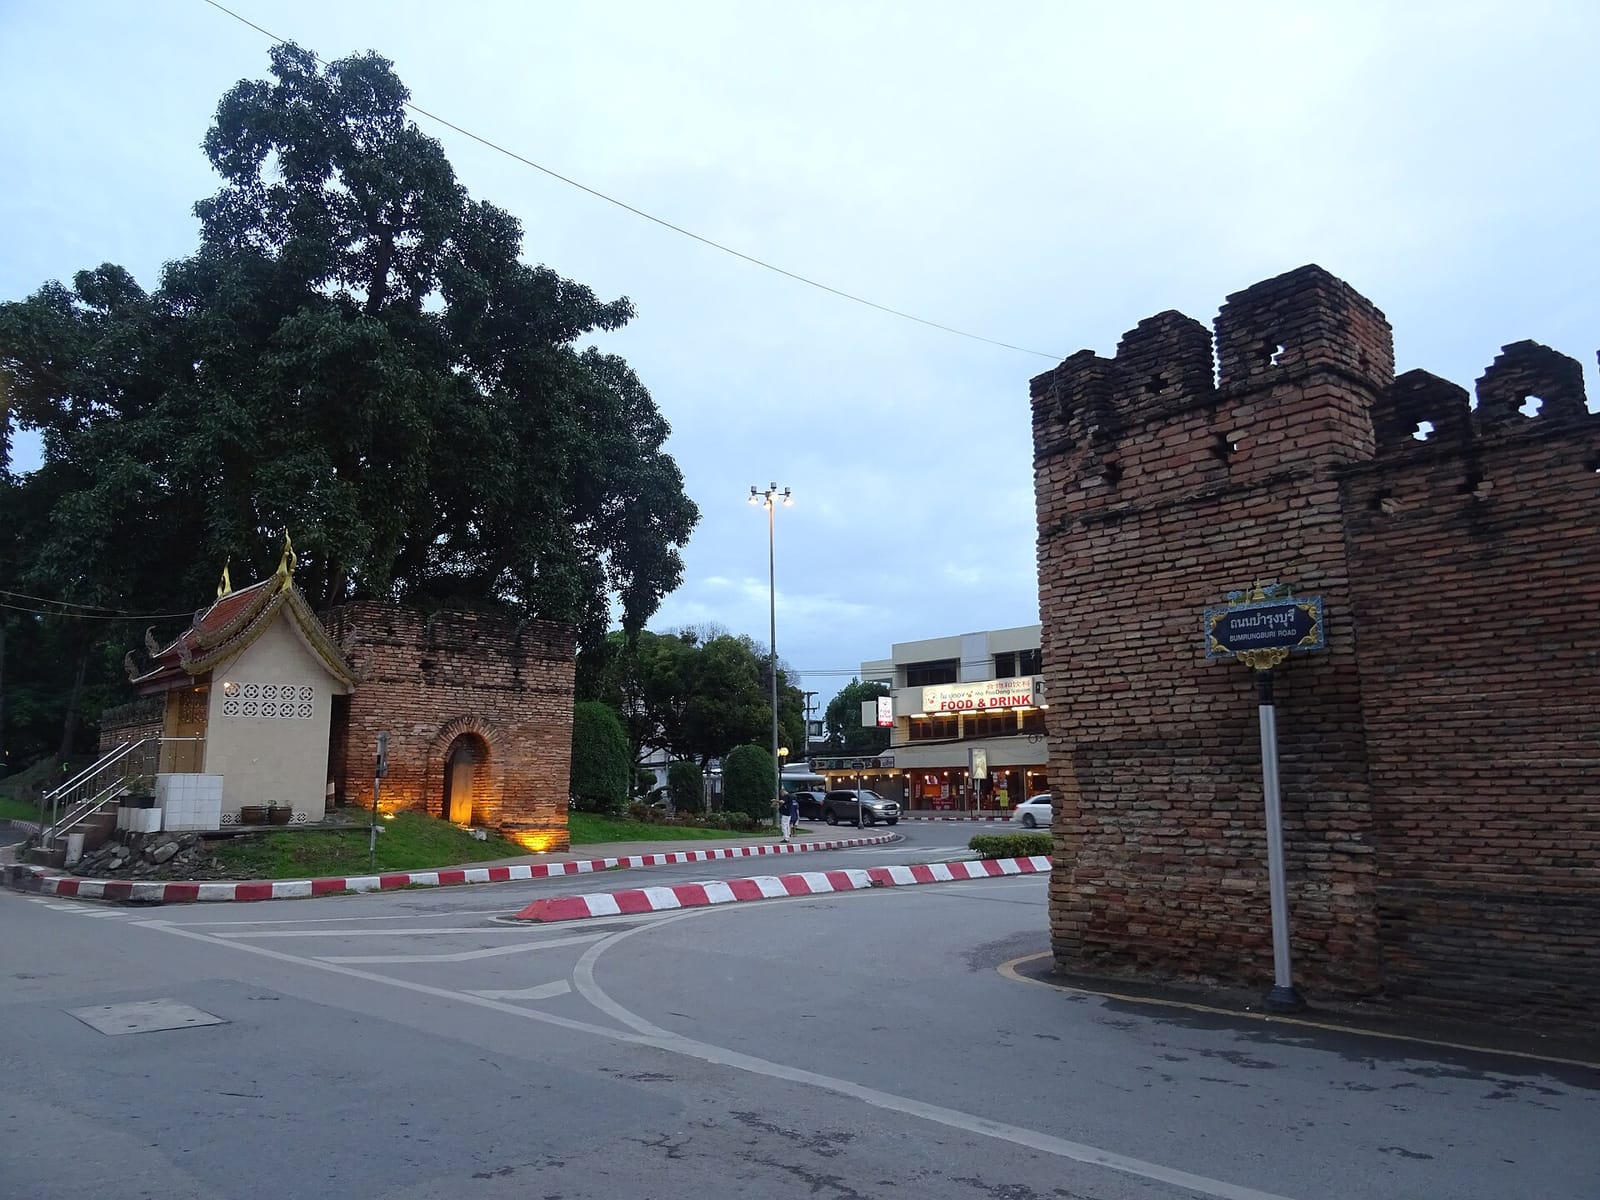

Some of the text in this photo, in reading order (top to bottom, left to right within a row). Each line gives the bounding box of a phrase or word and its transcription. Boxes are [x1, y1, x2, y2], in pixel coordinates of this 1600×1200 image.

[1230, 608, 1295, 629] ถนนบำรุงบุรี
[1229, 629, 1297, 642] BUMRUNGBURI ROAD
[940, 694, 1031, 711] FOOD & DRINK
